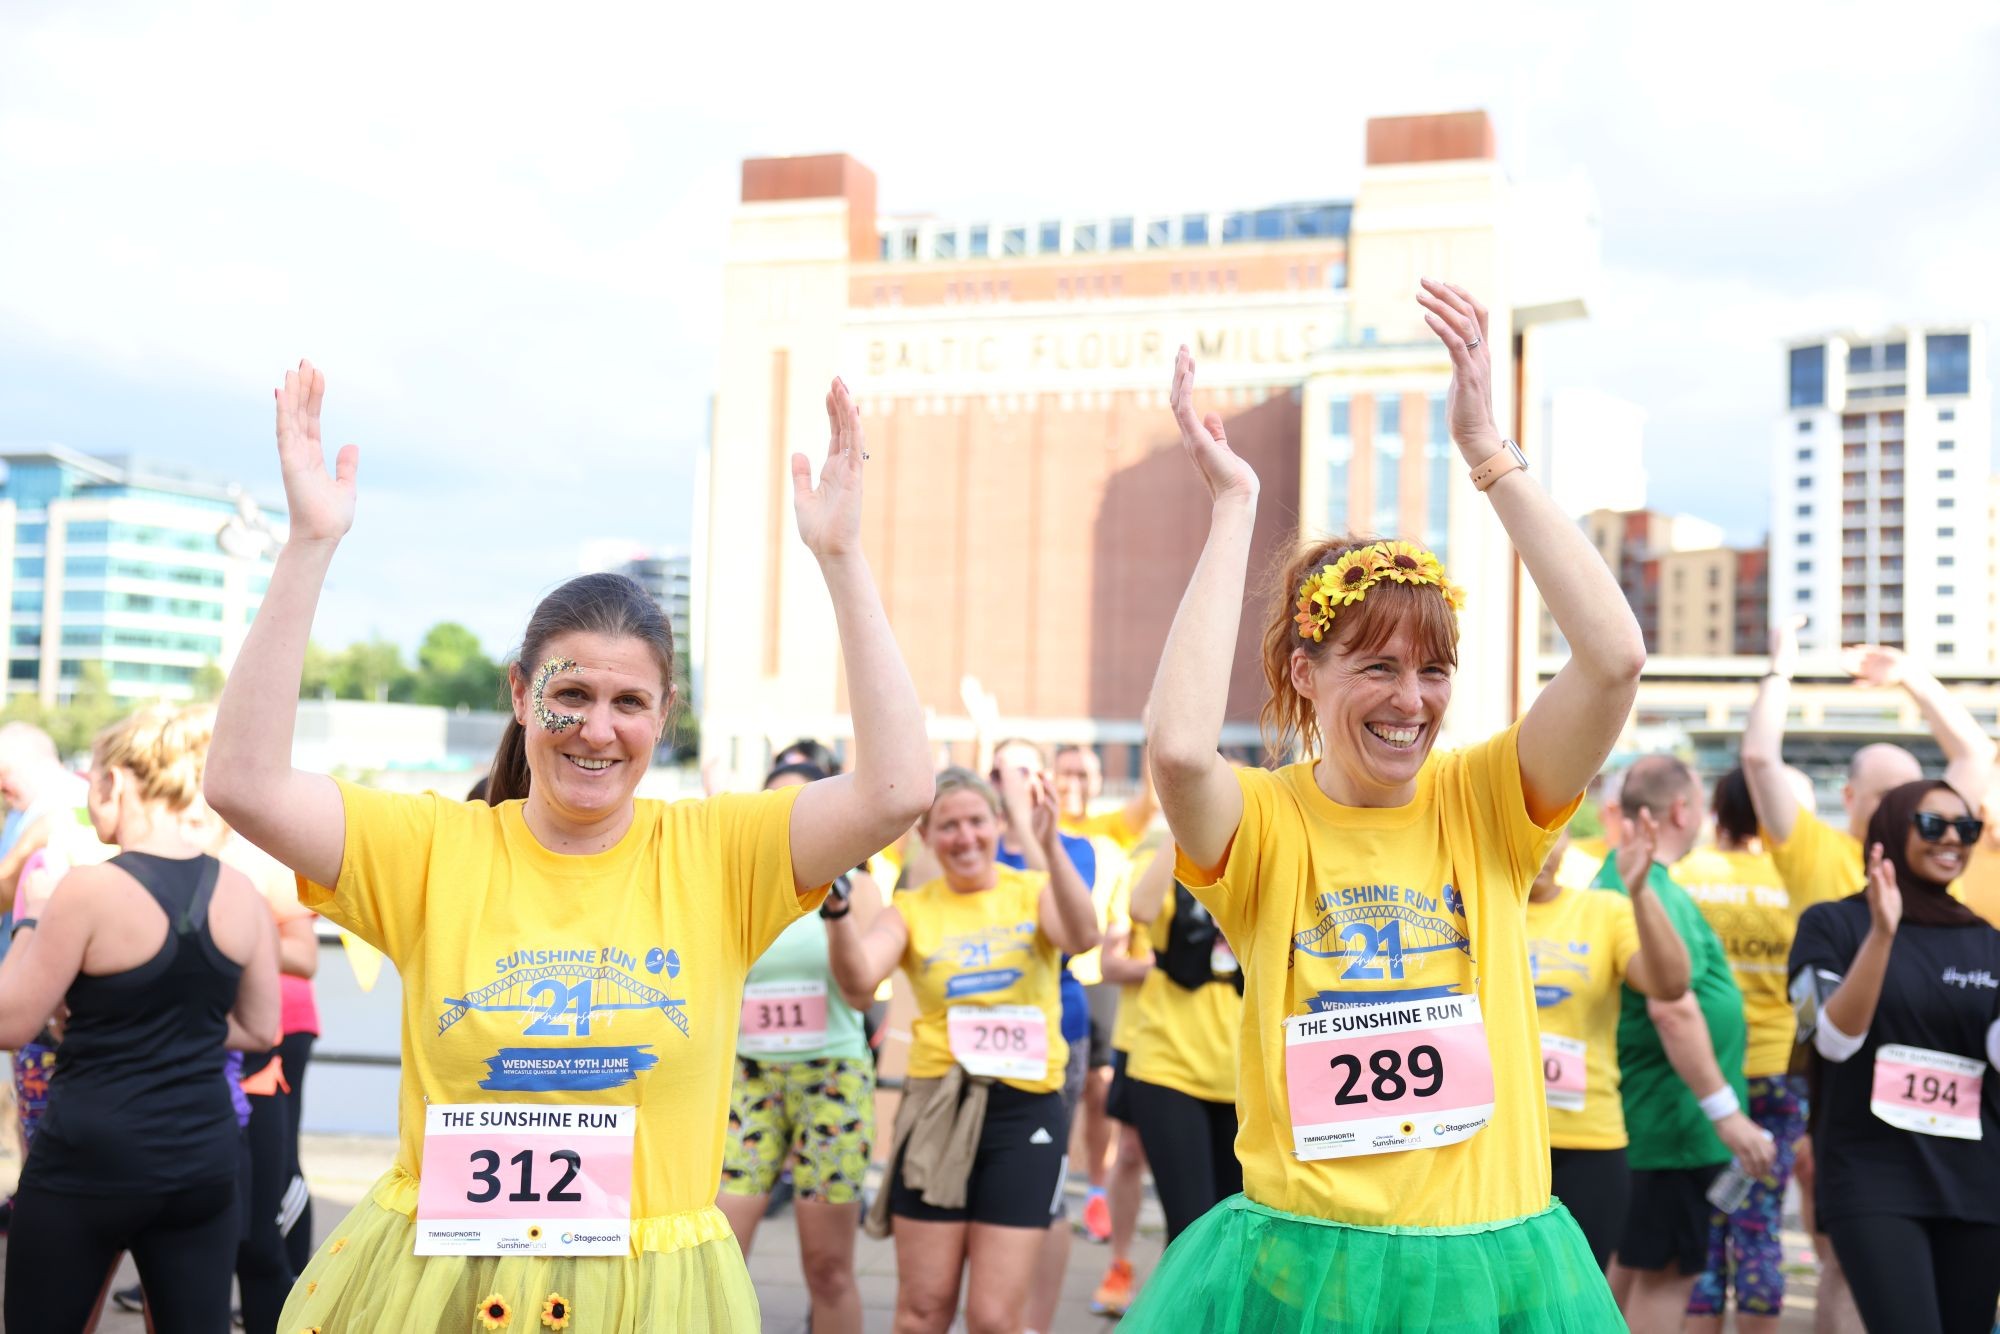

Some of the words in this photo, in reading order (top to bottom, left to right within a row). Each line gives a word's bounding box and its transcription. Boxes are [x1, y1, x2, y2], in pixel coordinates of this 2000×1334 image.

[867, 336, 999, 377] BALTIC
[1031, 328, 1164, 371] FLOUR
[1195, 324, 1320, 363] MILLS
[1314, 884, 1399, 917] SUNSHINE
[1404, 888, 1437, 912] RUN
[495, 949, 597, 974] SUNSHINE
[599, 946, 637, 973] RUN
[959, 942, 991, 968] 21
[1339, 919, 1405, 980] 21
[523, 979, 592, 1036] 21
[757, 1004, 805, 1029] 311
[1299, 1019, 1328, 1037] THE
[1332, 1008, 1422, 1032] SUNSHINE
[1426, 1003, 1463, 1021] RUN
[973, 1025, 1028, 1051] 208
[502, 1059, 572, 1069] WEDNESDAY
[574, 1058, 599, 1069] 19TH
[601, 1058, 629, 1068] JUNE
[1329, 1045, 1444, 1106] 289
[1902, 1073, 1958, 1107] 194
[442, 1112, 474, 1127] THE
[479, 1111, 572, 1128] SUNSHINE
[577, 1112, 618, 1129] RUN
[1303, 1132, 1355, 1143] TIMINGUPNORTH
[466, 1149, 582, 1203] 312
[573, 1233, 621, 1243] Stagecoach
